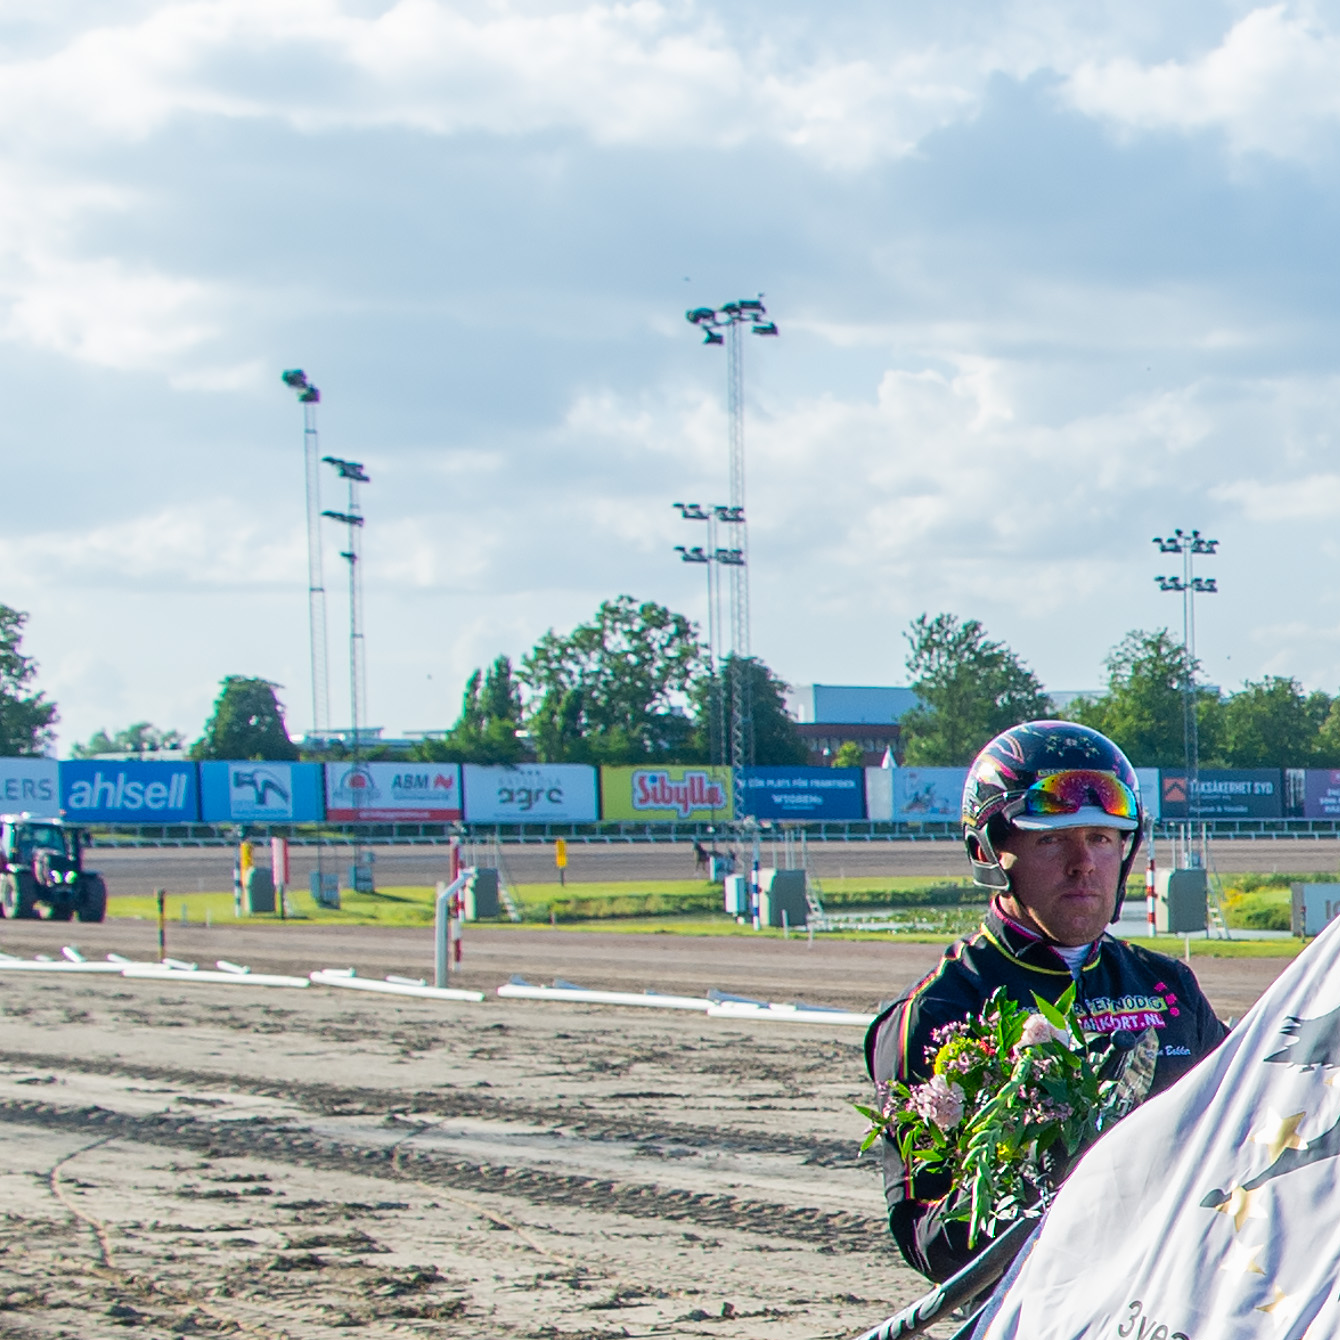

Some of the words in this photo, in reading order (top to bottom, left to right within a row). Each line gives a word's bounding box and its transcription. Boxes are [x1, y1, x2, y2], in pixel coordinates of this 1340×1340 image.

[0, 778, 52, 800] ERS
[69, 772, 188, 810] ahlsell
[391, 773, 429, 789] ABM
[1253, 781, 1274, 795] SYD
[637, 775, 722, 814] Sibylla
